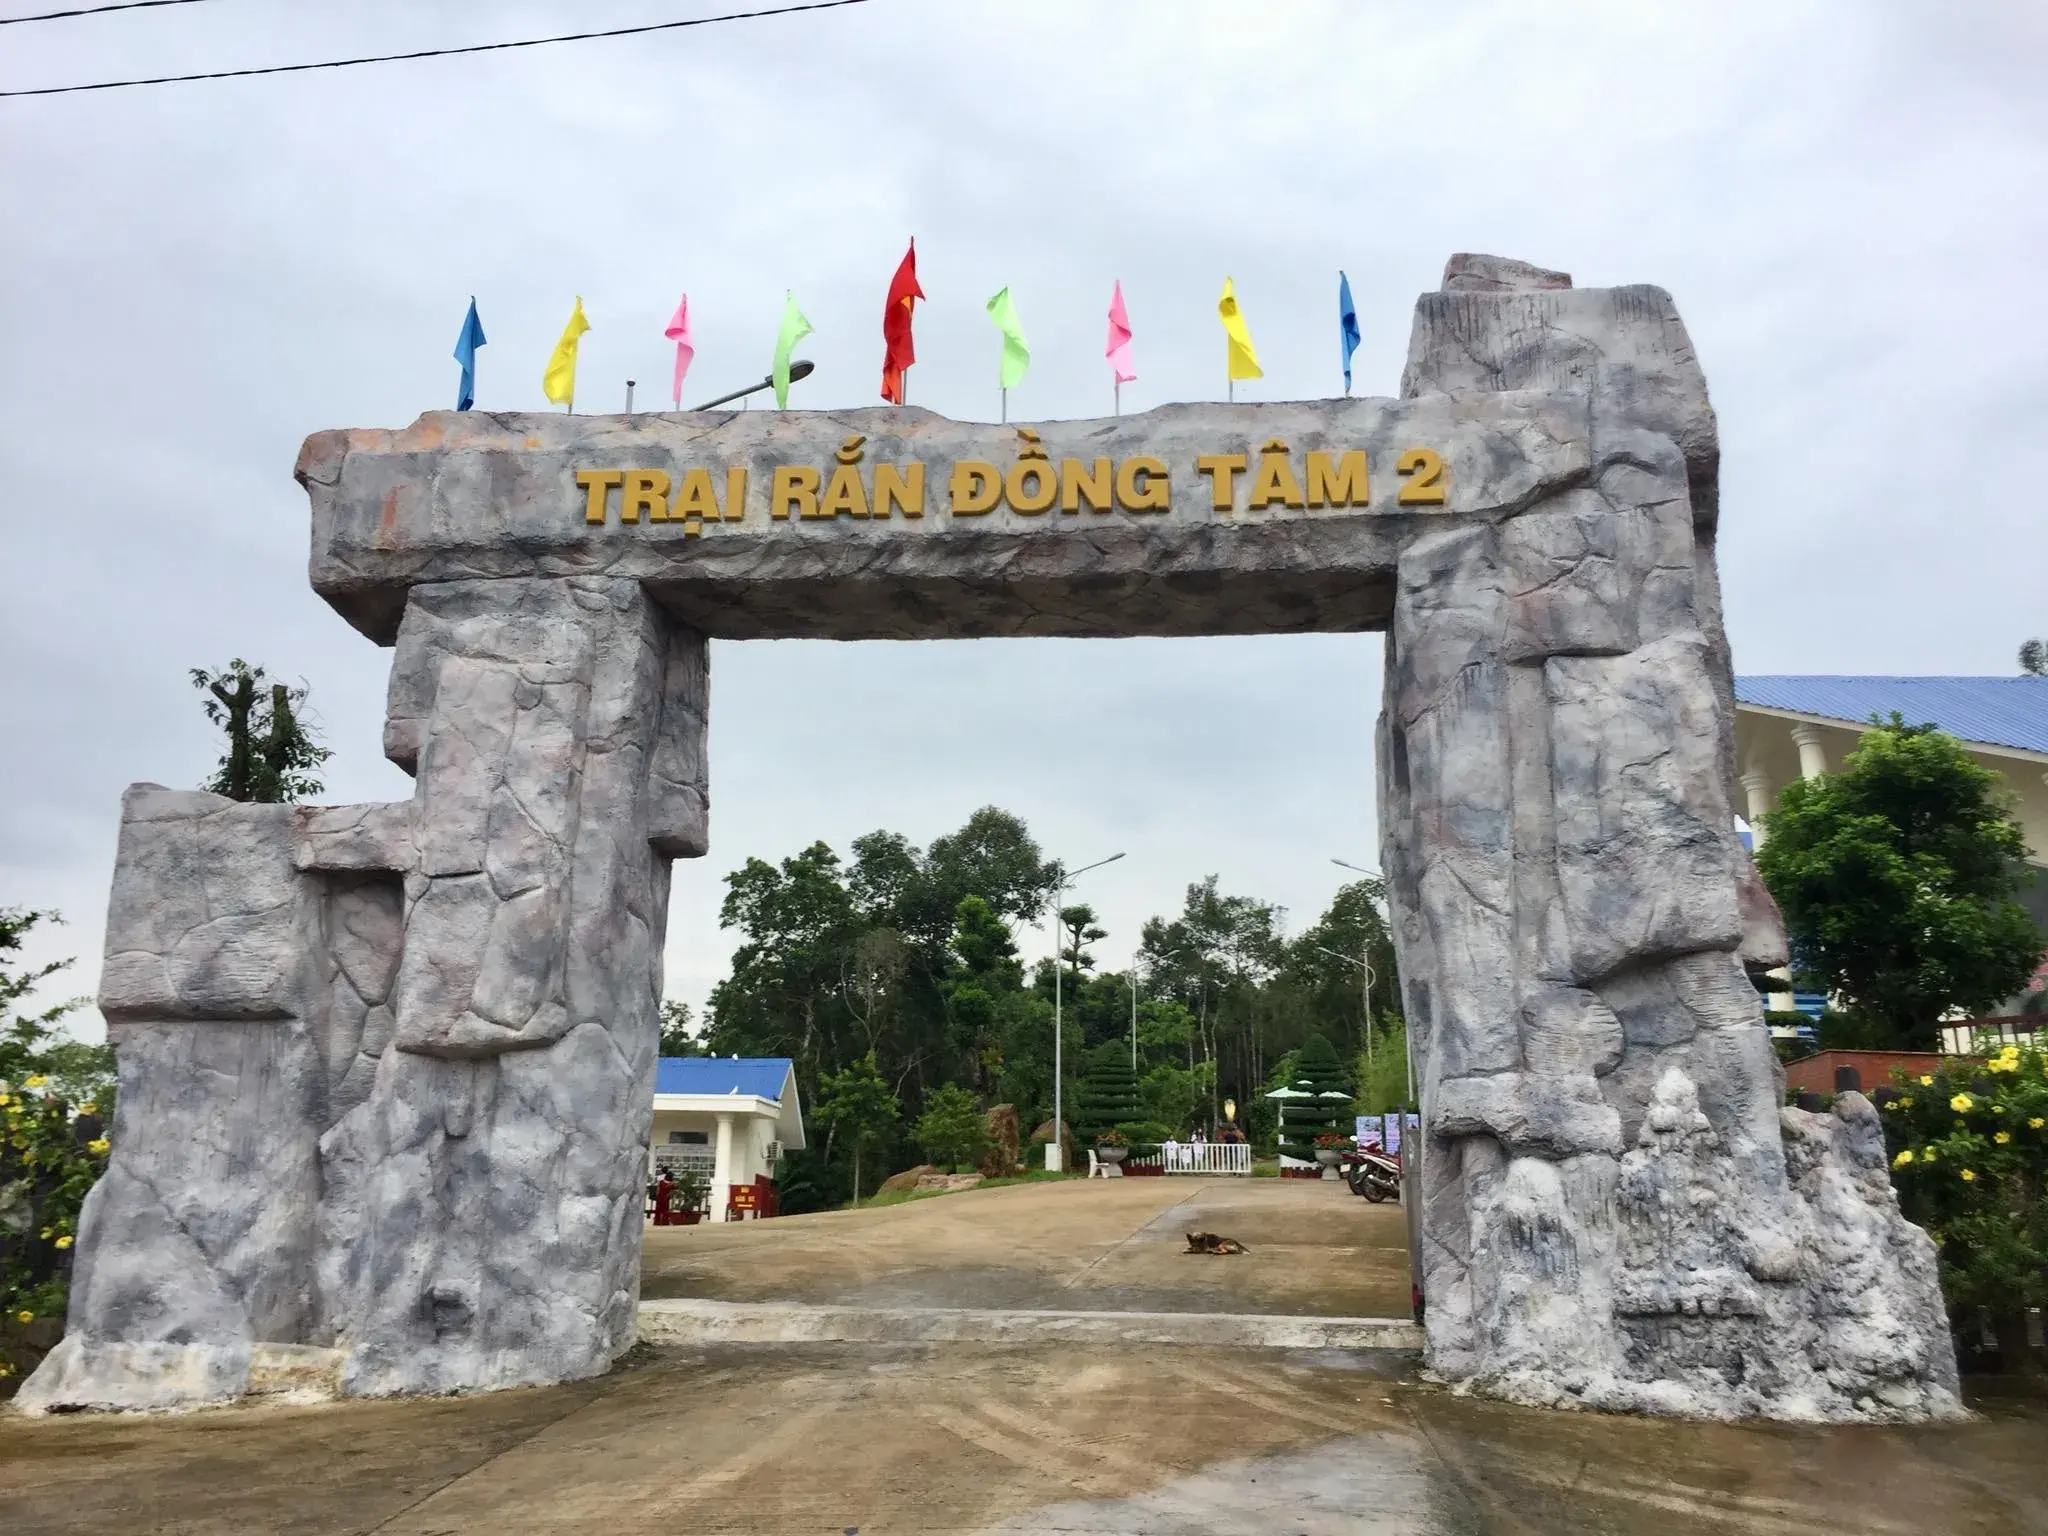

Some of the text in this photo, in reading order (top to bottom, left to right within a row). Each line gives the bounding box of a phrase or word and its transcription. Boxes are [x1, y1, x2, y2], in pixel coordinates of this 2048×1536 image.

[575, 428, 1446, 539] TRẠI RẮN ĐỒNG TÂM 2
